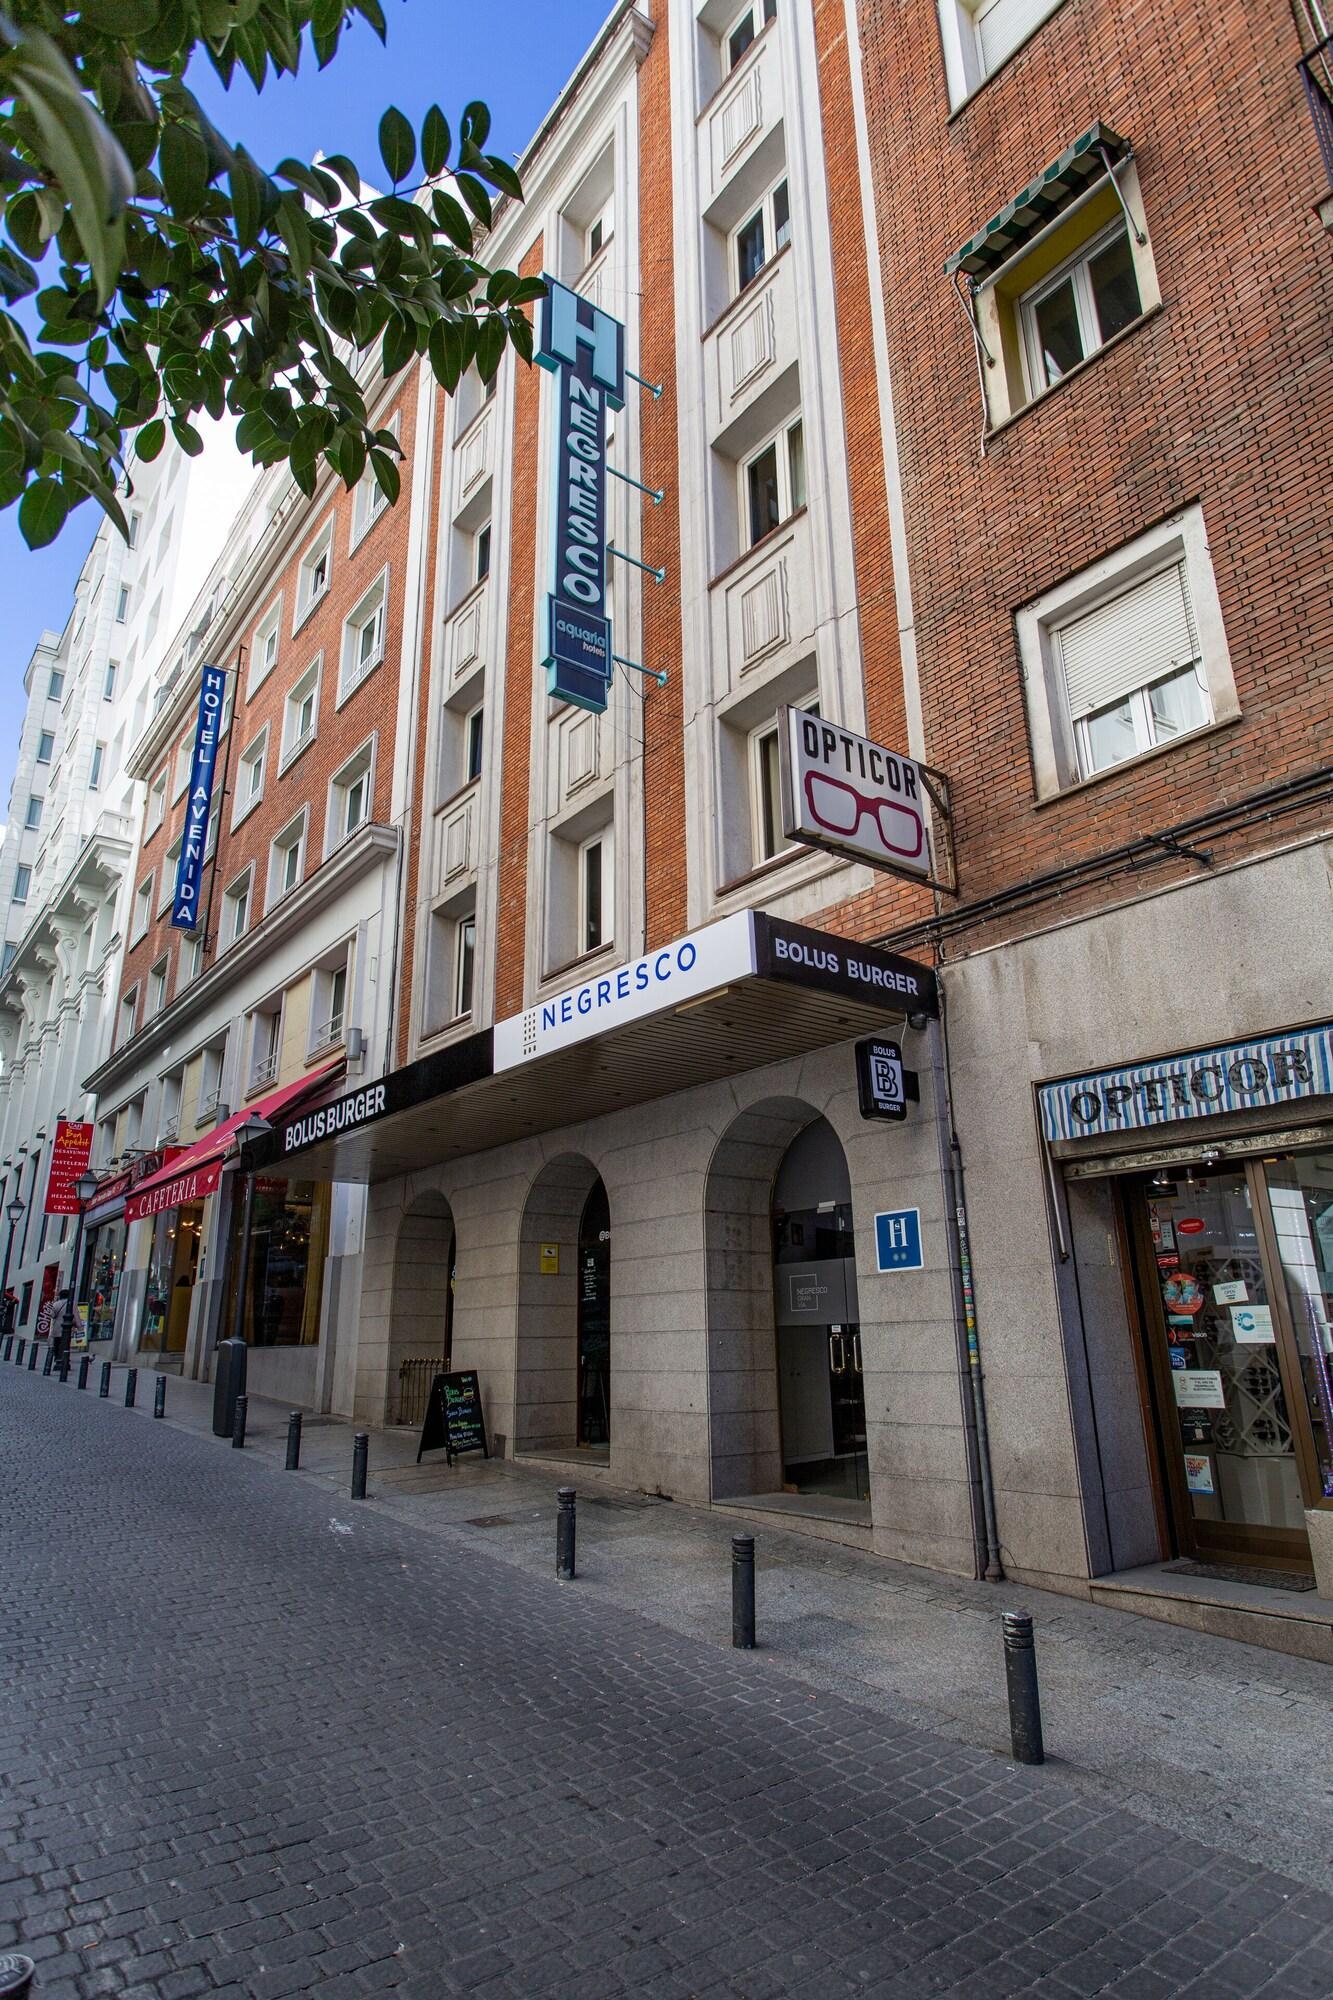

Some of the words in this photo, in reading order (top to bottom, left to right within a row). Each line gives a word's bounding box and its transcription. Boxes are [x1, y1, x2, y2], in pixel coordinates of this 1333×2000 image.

[550, 283, 617, 390] H
[563, 374, 602, 605] NEGRESCO
[556, 619, 606, 649] aquaria
[582, 641, 606, 658] hotels
[198, 674, 220, 764] HOTEL
[803, 719, 918, 800] OPTICOR
[176, 786, 208, 922] AVENIDA
[543, 942, 697, 1031] NEGRESCO
[774, 938, 839, 973] BOLUS
[847, 959, 919, 997] BURGER
[872, 1045, 896, 1058] BOLUS
[285, 1111, 326, 1152] BOLUS
[326, 1084, 386, 1134] BURGER
[879, 1102, 902, 1112] BURGER
[1070, 1048, 1314, 1125] OPTICOR
[139, 1175, 197, 1217] CAFETERIA
[888, 1217, 909, 1248] H
